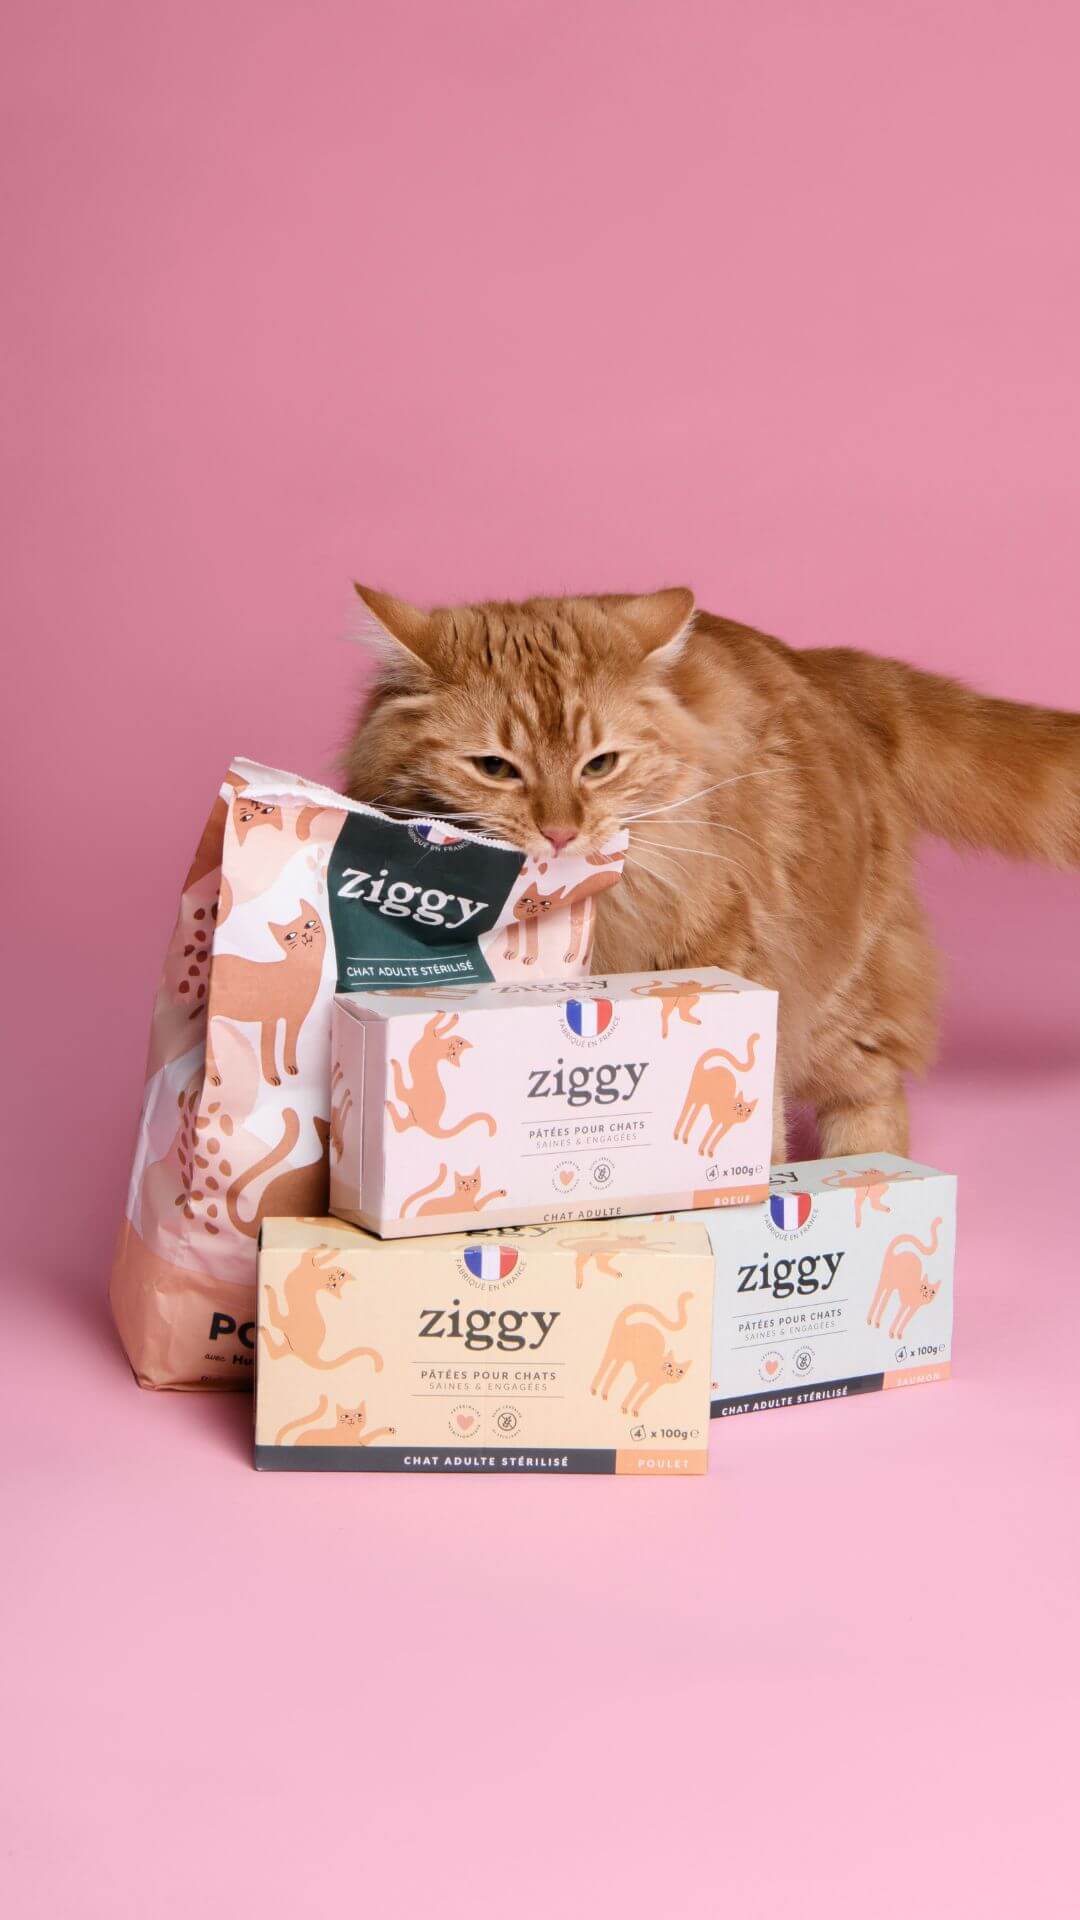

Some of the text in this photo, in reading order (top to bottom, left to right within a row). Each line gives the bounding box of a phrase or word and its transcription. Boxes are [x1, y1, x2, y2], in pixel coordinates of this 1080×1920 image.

[337, 868, 489, 929] ziggy
[346, 961, 474, 977] CHAT ADULTE STÉRILISÉ
[599, 1016, 620, 1043] FRANCE
[527, 1058, 650, 1107] ziggy
[529, 1121, 646, 1139] PÂTÉES POUR CHATS
[536, 1133, 638, 1149] SAINES & ENGAGÉES
[713, 1194, 751, 1207] BOEUF
[543, 1206, 622, 1222] CHAT ADULTE
[456, 1258, 527, 1292] FABRIQUÉ EN FRANCE
[736, 1252, 846, 1299] ziggy
[418, 1298, 561, 1351] ziggy
[738, 1308, 842, 1332] PÂTÉES POUR CHATS
[745, 1329, 776, 1341] SAINES
[789, 1320, 835, 1334] ENGAGÉES
[421, 1368, 557, 1381] PÂTÉES POUR CHATS
[429, 1381, 548, 1392] SAINES & ENGAGÉES
[721, 1386, 848, 1416] CHAT ADULTE STÉRILISÉ
[403, 1455, 569, 1467] CHAT ADULTE STÉRILISÉ
[637, 1458, 689, 1469] POULET
